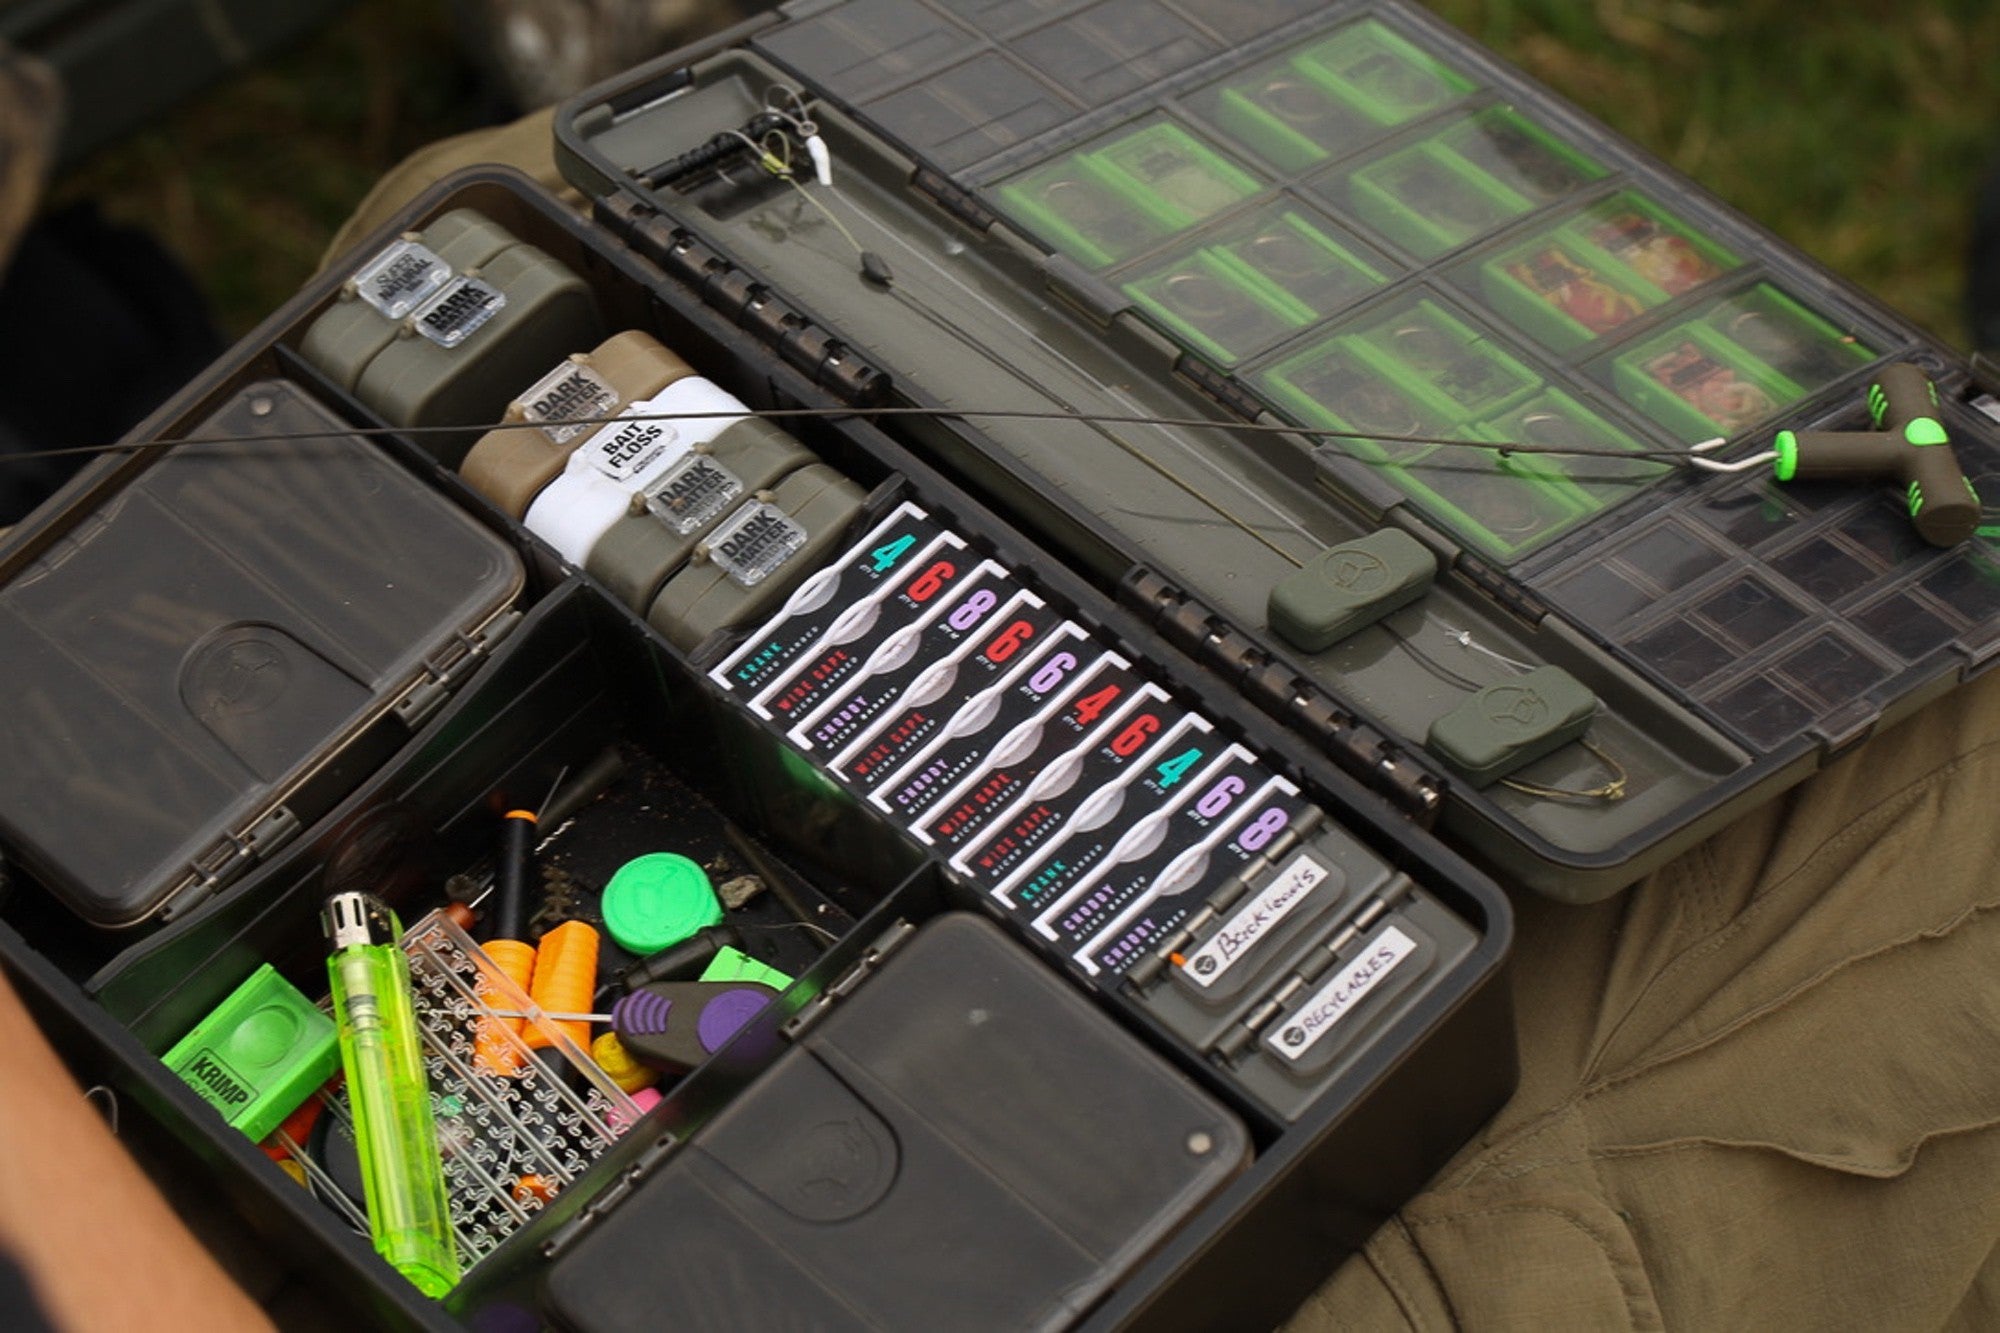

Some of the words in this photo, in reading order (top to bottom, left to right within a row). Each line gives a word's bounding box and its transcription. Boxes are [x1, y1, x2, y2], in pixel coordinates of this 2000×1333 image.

[376, 253, 416, 285] SUPER
[378, 258, 434, 301] NATURAL
[423, 281, 477, 326] DARK
[434, 288, 489, 332] MATTER
[533, 371, 590, 417] DARK
[546, 382, 603, 422] MATTER
[602, 421, 643, 456] BAIT
[608, 424, 664, 469] FLOSS
[656, 459, 715, 507] DARK
[719, 510, 777, 558] DARK
[732, 520, 789, 568] MATTER
[871, 534, 917, 573] 4
[907, 560, 956, 602] 6
[948, 588, 997, 631] 8
[737, 642, 783, 680] KRANK
[986, 620, 1034, 663] 6
[777, 680, 814, 710] WIDE
[812, 650, 848, 681] GAPE
[1029, 652, 1078, 694] 6
[815, 695, 868, 741] CHODDY
[1075, 684, 1122, 725] 4
[854, 743, 891, 775] WIDE
[889, 712, 926, 743] GAPE
[1110, 713, 1161, 756] 6
[897, 758, 949, 804] CHODDY
[1157, 747, 1203, 789] 4
[938, 803, 976, 835] WIDE
[974, 773, 1011, 804] GAPE
[1196, 775, 1246, 818] 6
[979, 836, 1016, 868] WIDE
[1014, 805, 1051, 837] GAPE
[1238, 806, 1289, 852] 8
[1020, 860, 1067, 901] KRANK
[1062, 883, 1115, 931] CHODDY
[1102, 917, 1156, 966] CHODDY
[190, 1056, 250, 1106] KRIMP
